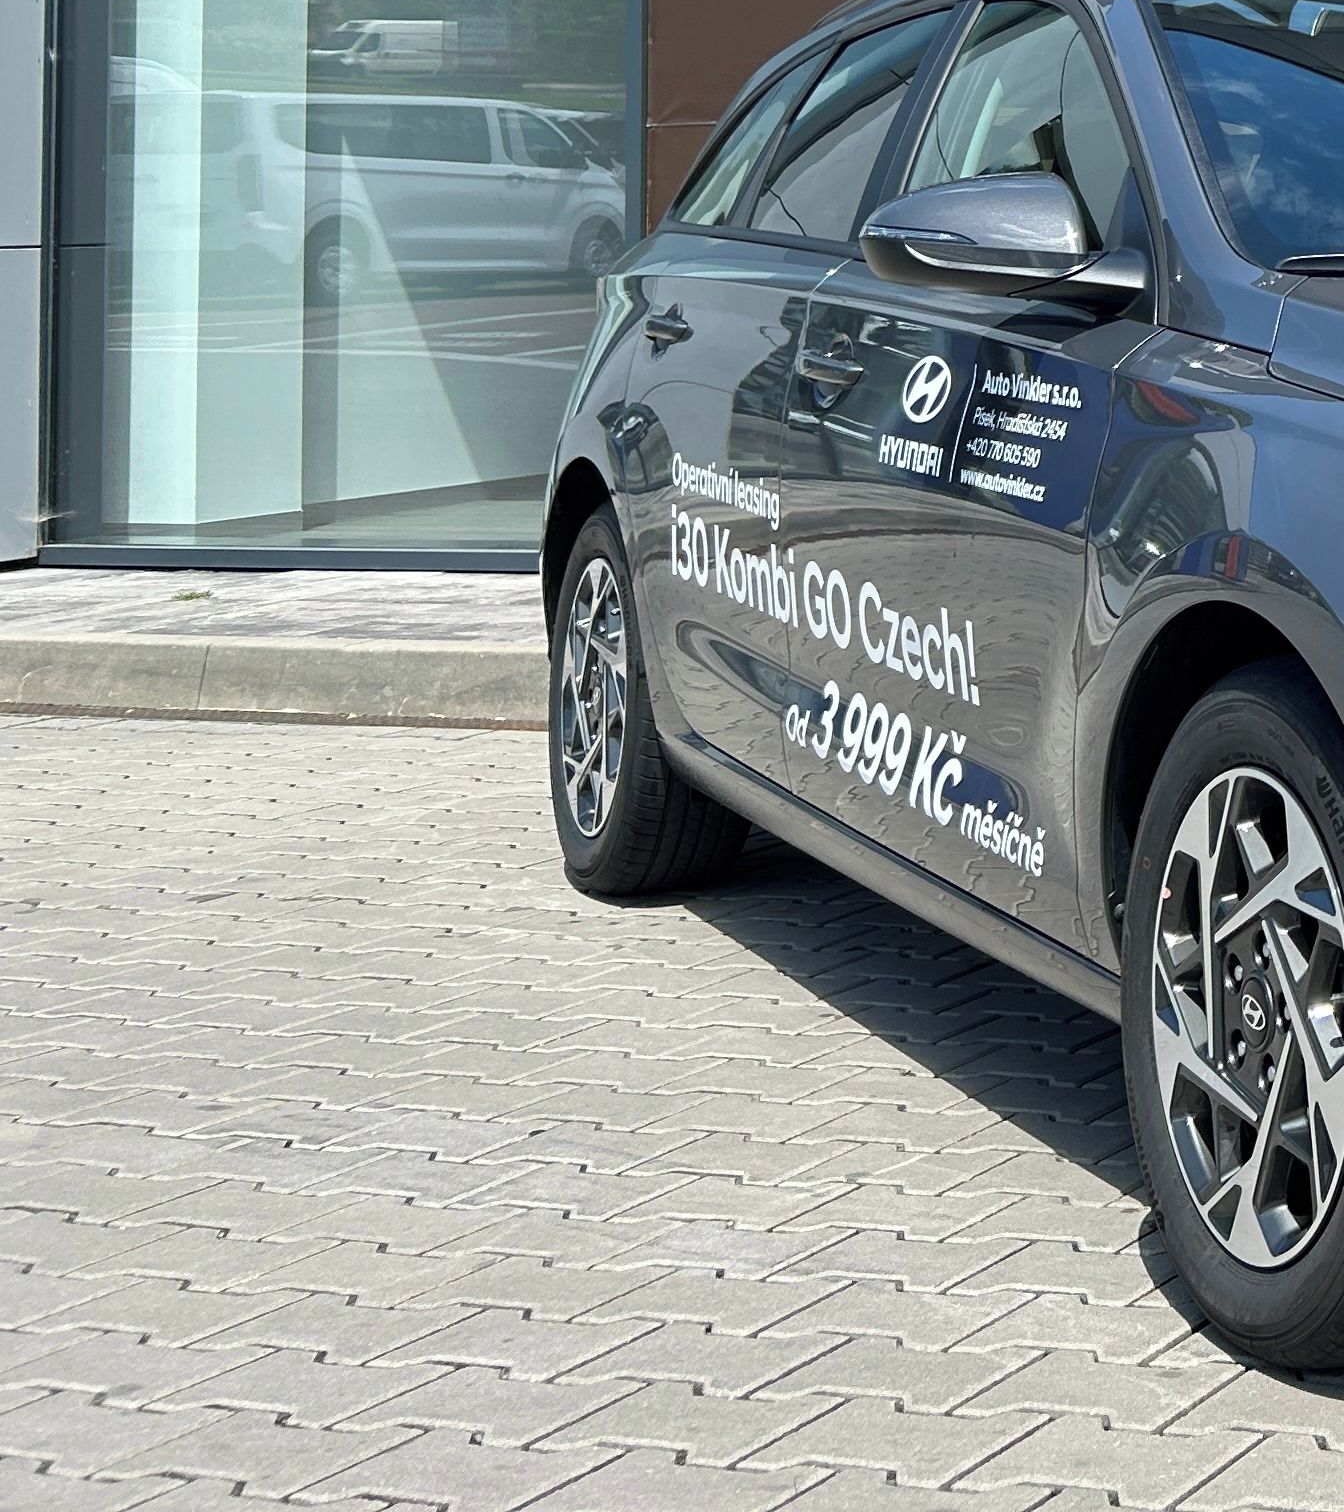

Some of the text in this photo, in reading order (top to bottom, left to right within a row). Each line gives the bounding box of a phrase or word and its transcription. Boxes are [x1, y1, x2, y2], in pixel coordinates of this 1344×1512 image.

[982, 369, 1082, 409] Auto Vinkler s.r.o.
[1040, 419, 1068, 442] 2454
[879, 434, 944, 478] HYUNDAI
[966, 437, 1042, 469] +420 770 605 590
[672, 452, 781, 531] Operativní leasing
[960, 468, 1046, 503] www.autovinkler.cz
[671, 504, 709, 588] i30
[713, 524, 799, 628] Kombi
[803, 561, 850, 649] GO
[858, 581, 981, 707] Czech!
[812, 680, 839, 759] 3
[837, 692, 912, 796] 999
[960, 800, 1047, 877] měsíčně
